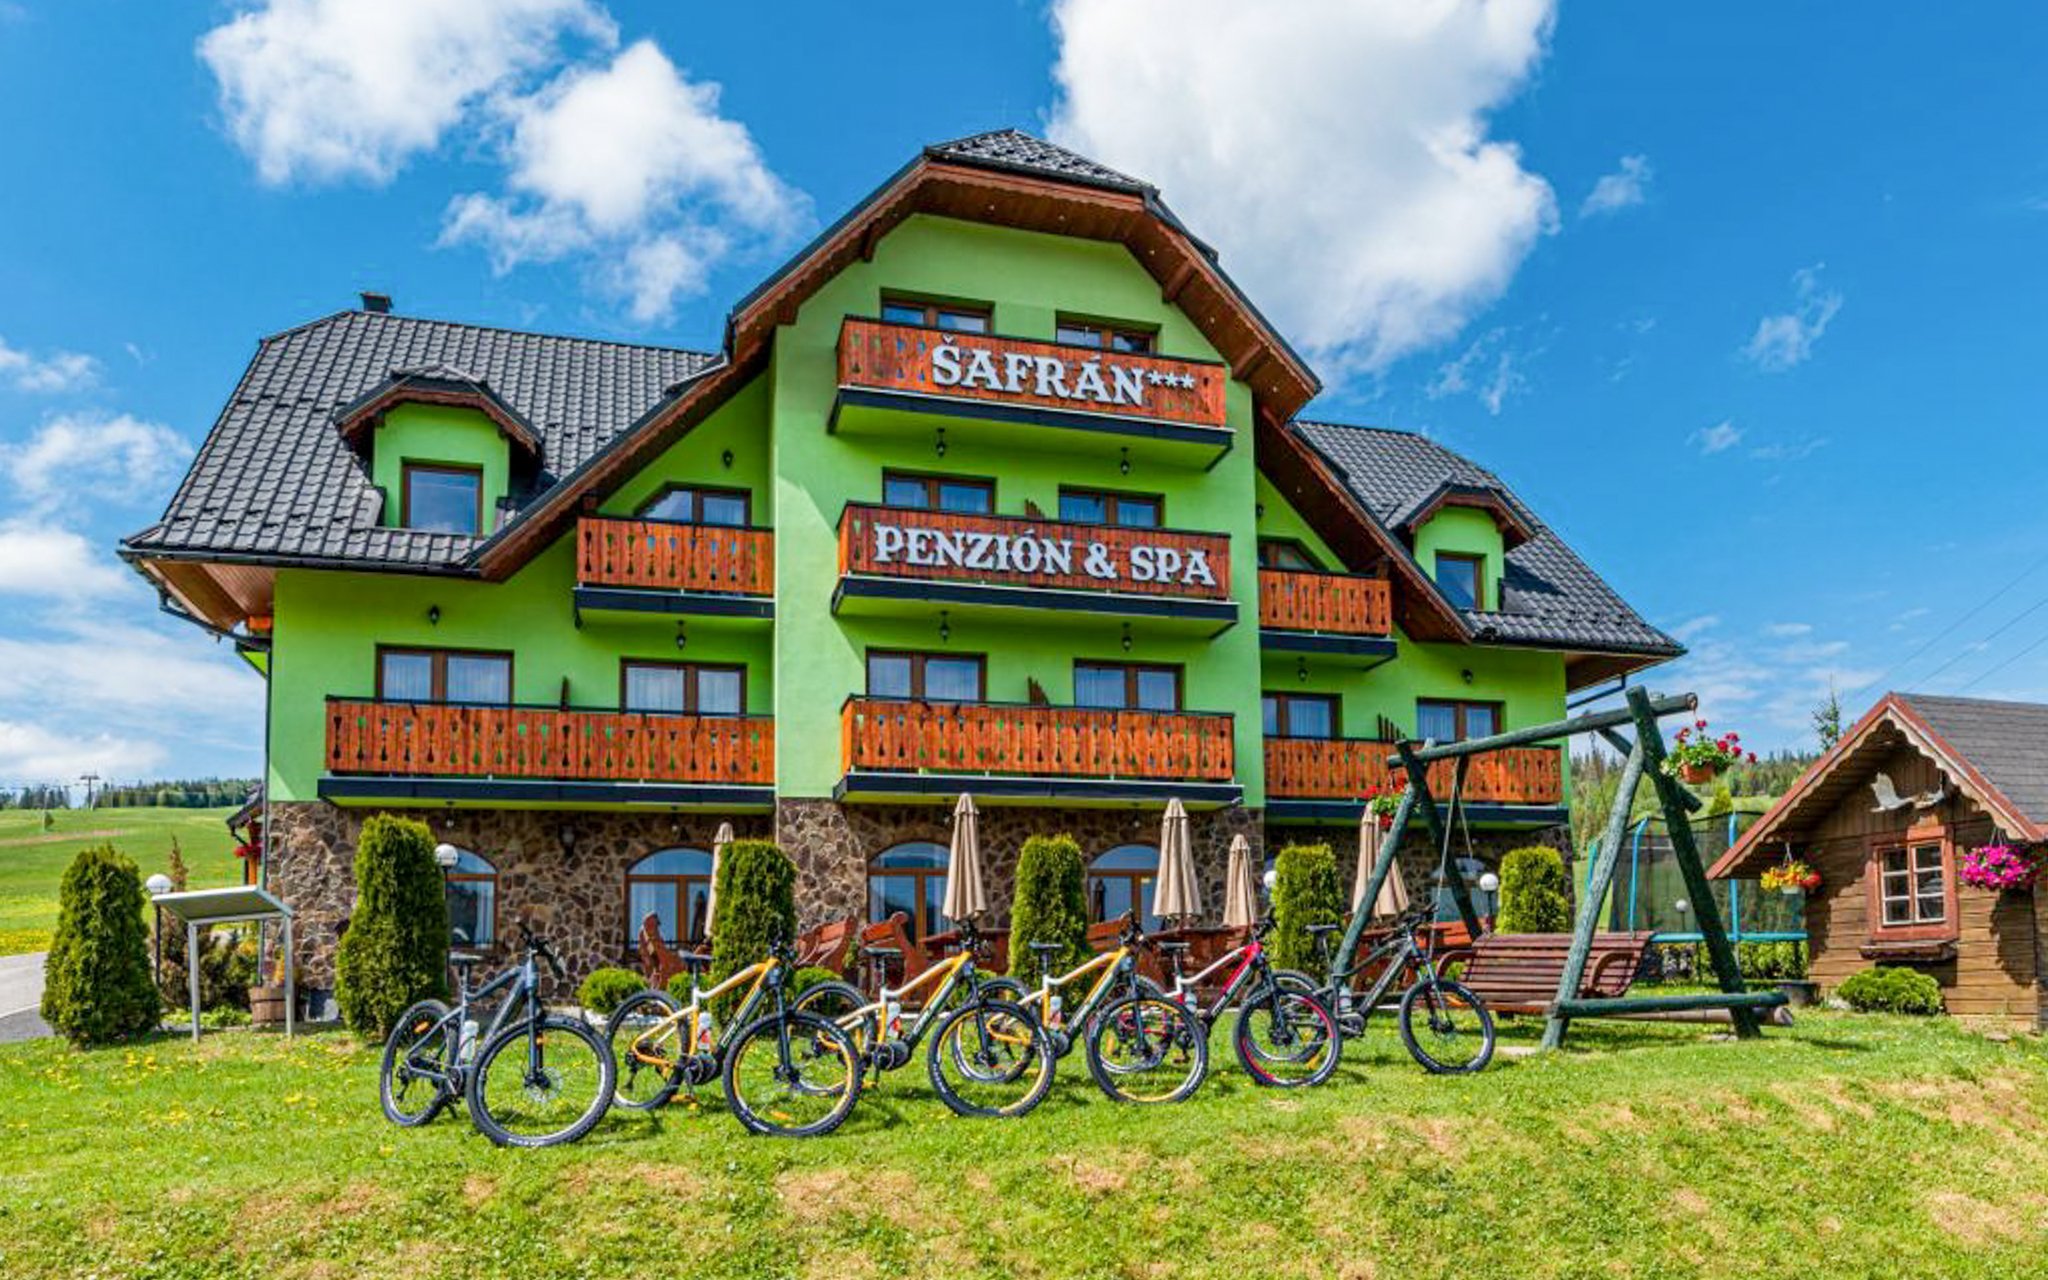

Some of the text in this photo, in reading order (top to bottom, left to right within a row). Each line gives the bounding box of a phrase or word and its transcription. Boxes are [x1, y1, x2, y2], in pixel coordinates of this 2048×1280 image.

[874, 522, 1217, 587] PENZIÓN & SPA
